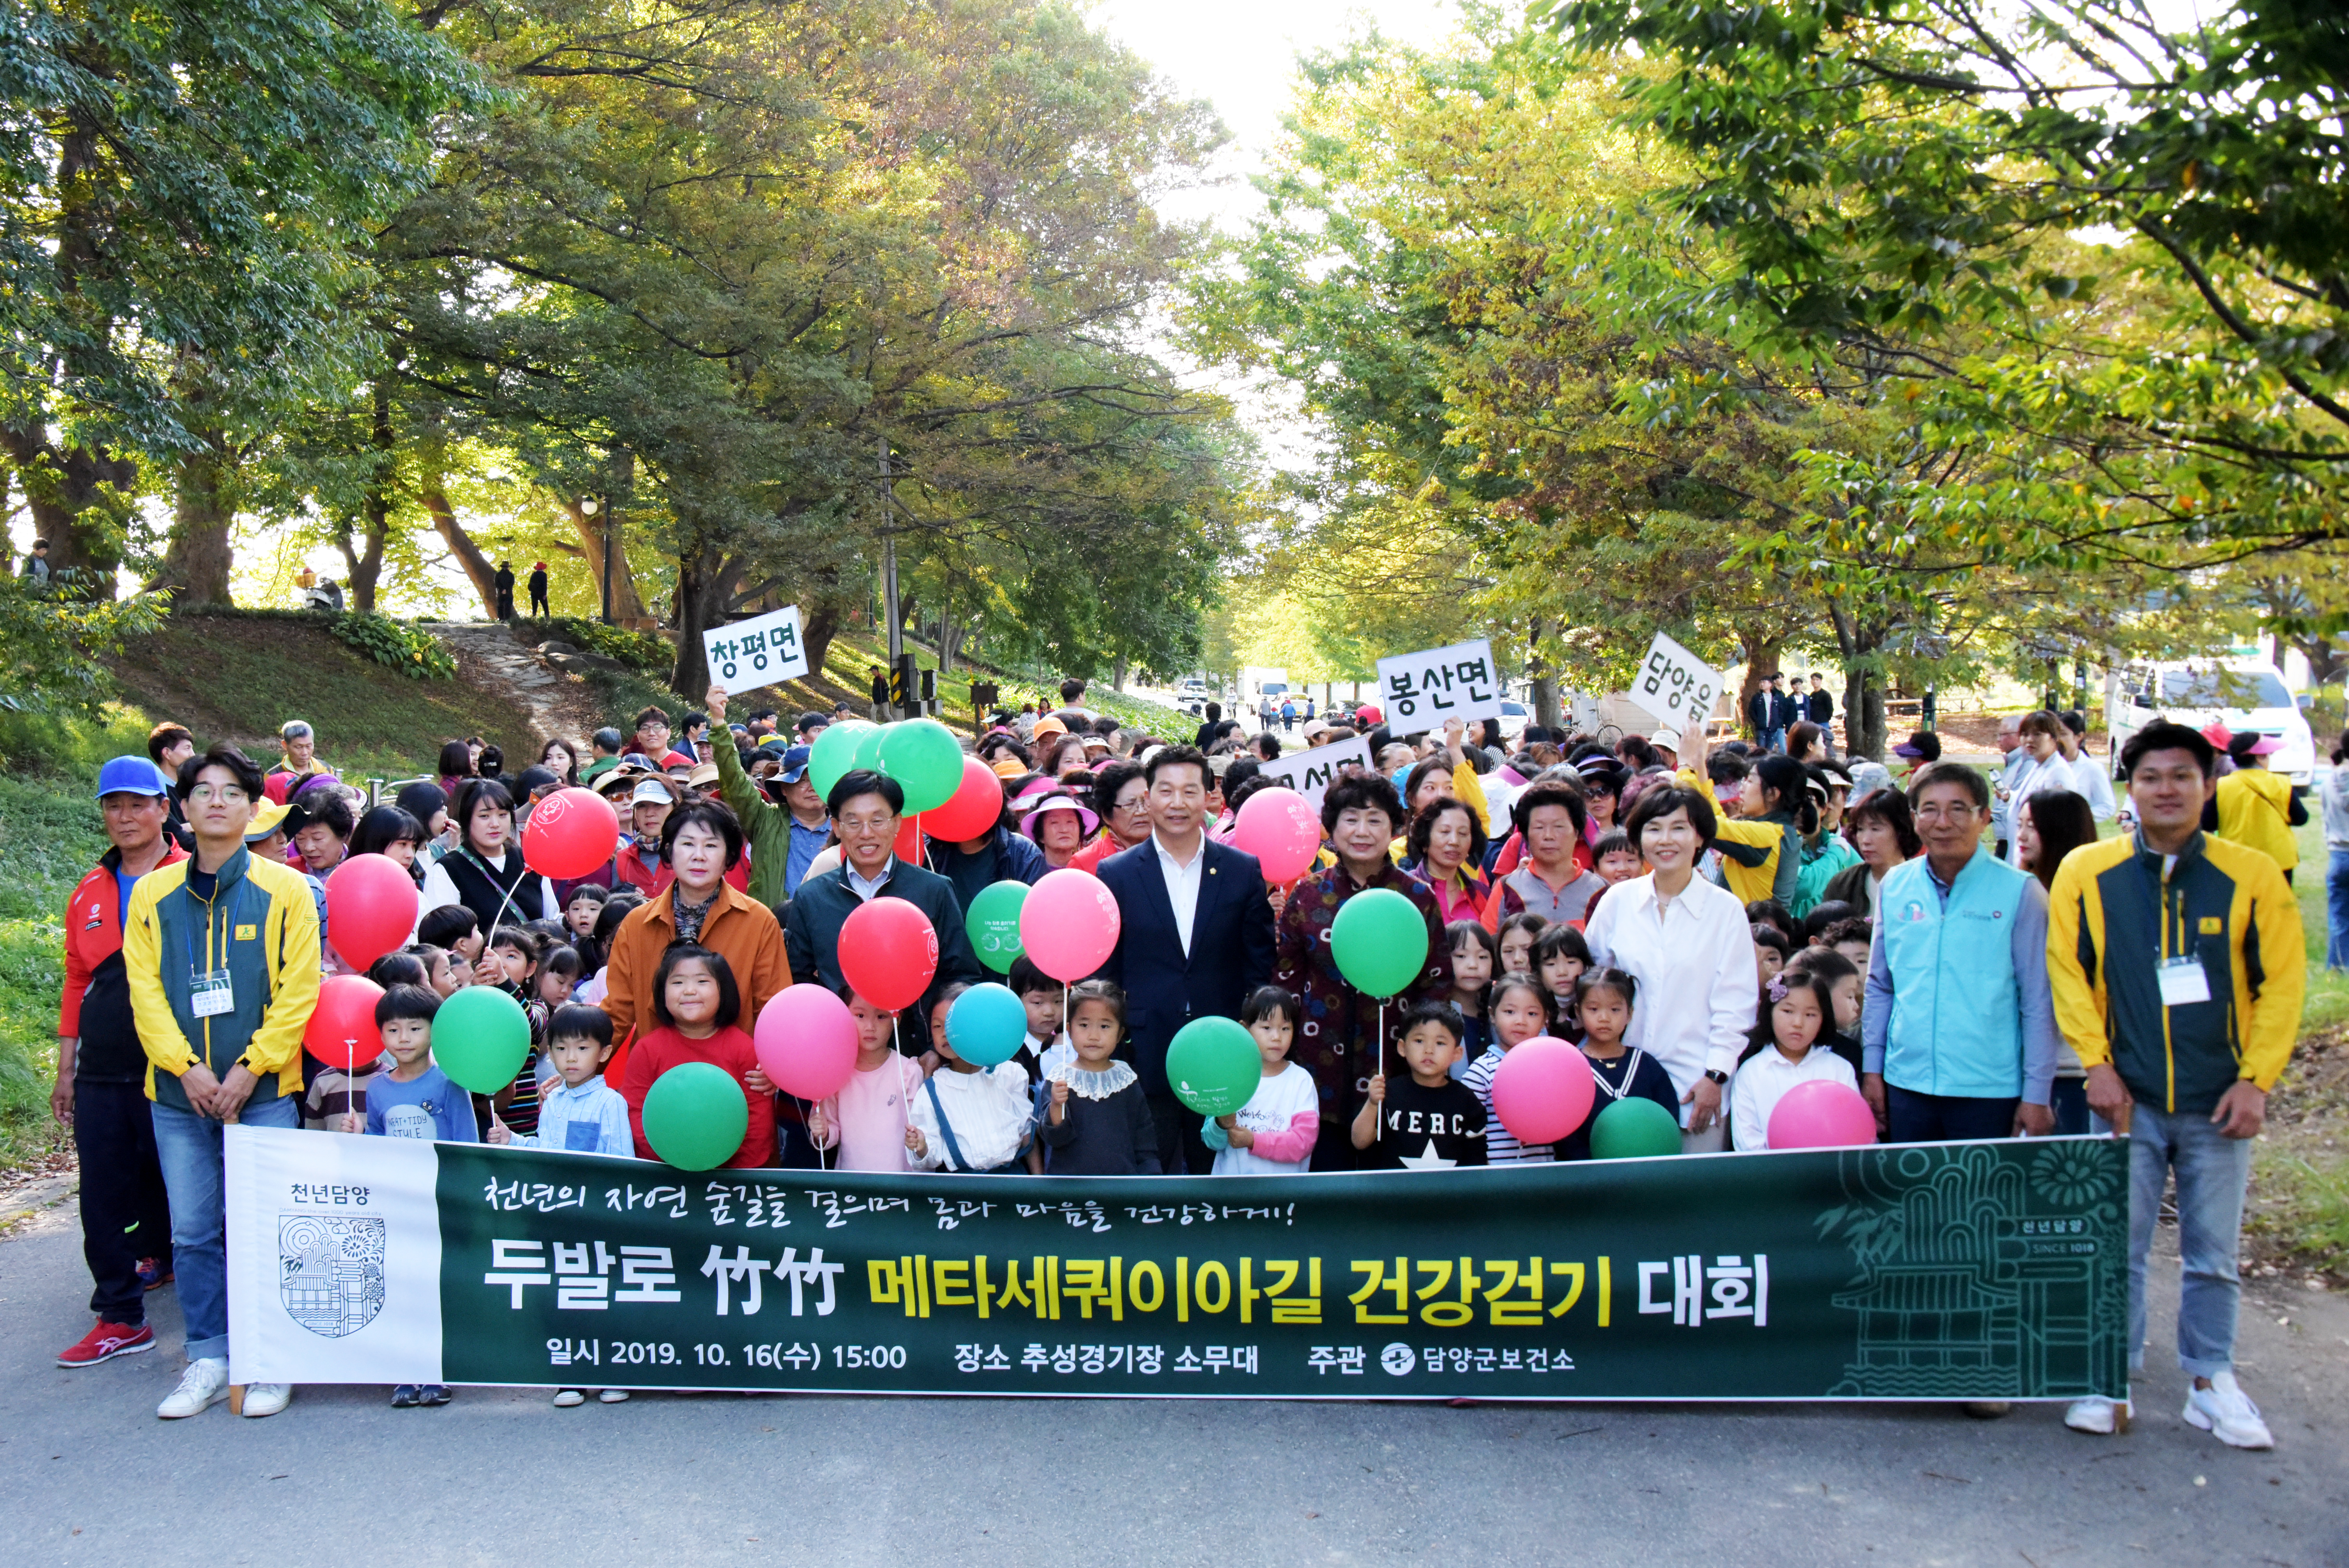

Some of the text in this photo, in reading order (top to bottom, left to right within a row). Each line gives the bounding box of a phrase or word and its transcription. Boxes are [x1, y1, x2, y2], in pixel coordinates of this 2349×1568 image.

[710, 622, 798, 679] 창평면
[1388, 657, 1492, 716] 봉산면
[1644, 651, 1711, 722] 담양읍
[291, 1183, 370, 1205] 천년담양
[484, 1176, 1295, 1232] 천년의 자연 숲길을 걸으며 몸과 마음을 건강하게!
[2033, 1244, 2067, 1253] SINCE
[485, 1239, 1768, 1327] 두발로 竹竹 메타세쿼이아길 건강걷기 대회
[547, 1338, 906, 1370] 일시 2019. 10. 16(수) 15:00
[954, 1343, 1258, 1374] 장소 추성경기장 소무대
[1308, 1346, 1575, 1374] 주관 담양군보건소
